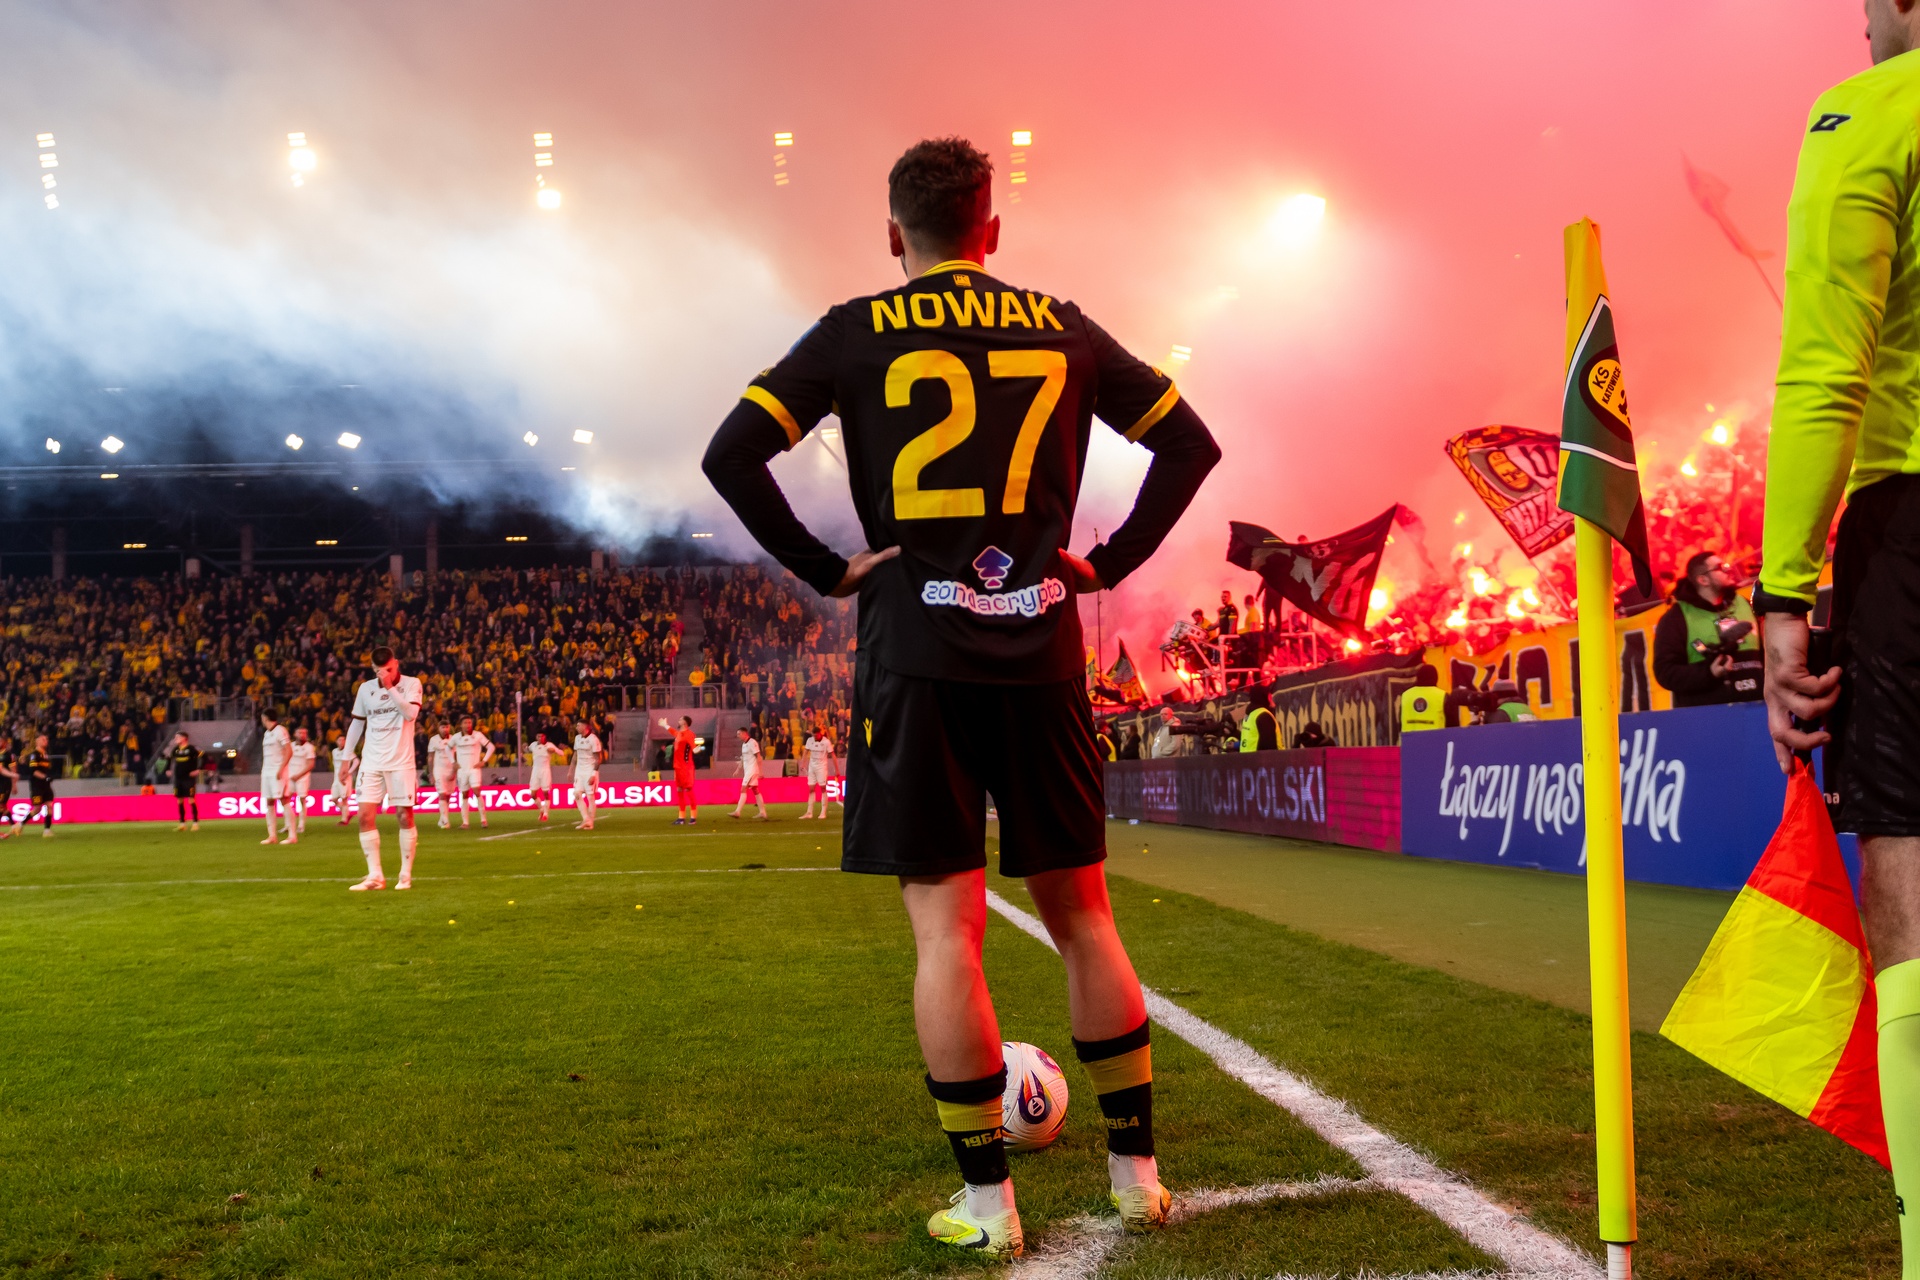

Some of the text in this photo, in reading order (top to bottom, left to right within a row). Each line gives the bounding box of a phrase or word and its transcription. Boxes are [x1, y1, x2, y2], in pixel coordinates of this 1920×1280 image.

[870, 289, 1065, 334] NOWAK
[1592, 366, 1610, 390] KS
[1602, 365, 1621, 405] KATOWICE
[884, 349, 1068, 521] 27
[923, 579, 1065, 615] zondacrypto
[1240, 765, 1326, 823] POLSKI
[1438, 741, 1521, 857] Łączy
[1522, 762, 1583, 836] nas
[961, 1127, 1002, 1148] 1964
